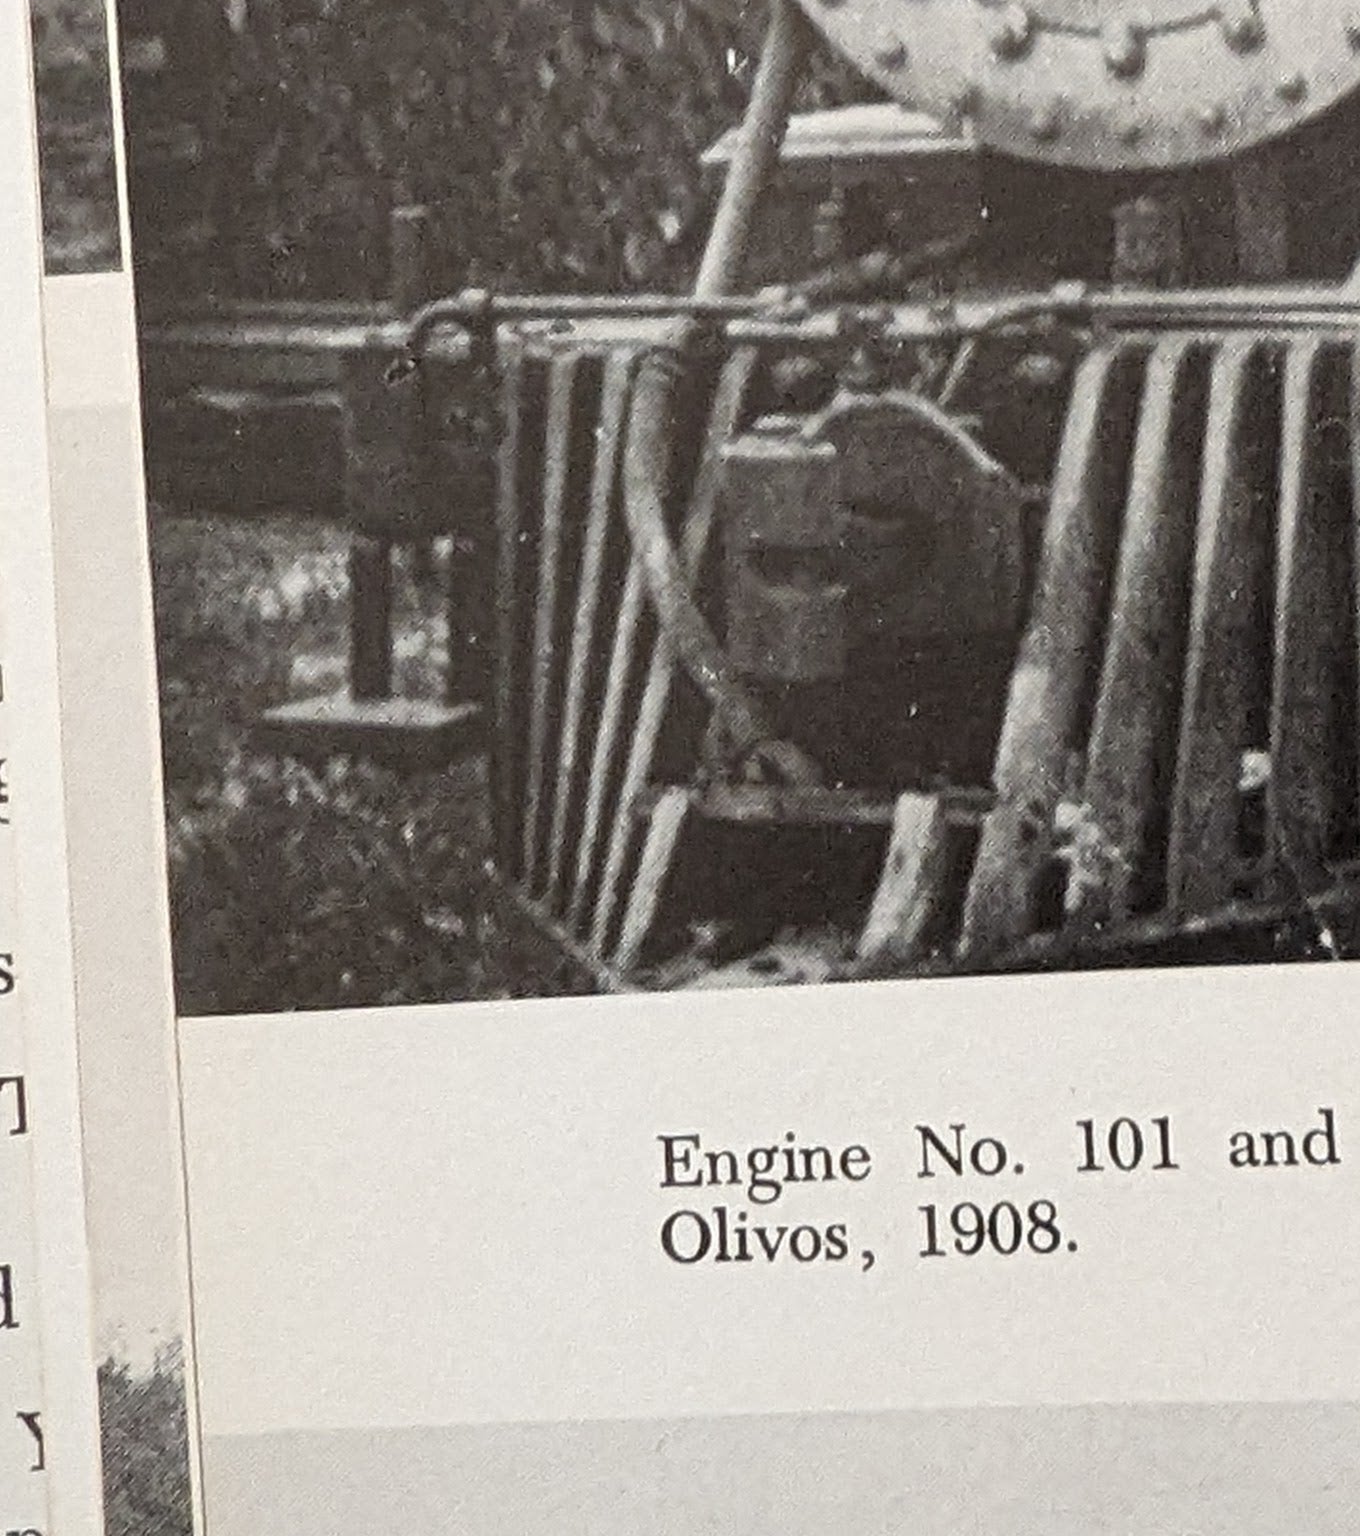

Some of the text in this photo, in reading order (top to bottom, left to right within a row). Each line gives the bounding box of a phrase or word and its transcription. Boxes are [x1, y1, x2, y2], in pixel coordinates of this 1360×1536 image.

[656, 1131, 872, 1206] Engine
[915, 1123, 1025, 1179] No.
[1076, 1116, 1179, 1172] 101
[1228, 1107, 1342, 1168] and
[660, 1199, 1078, 1272] Olivos, 1908.
